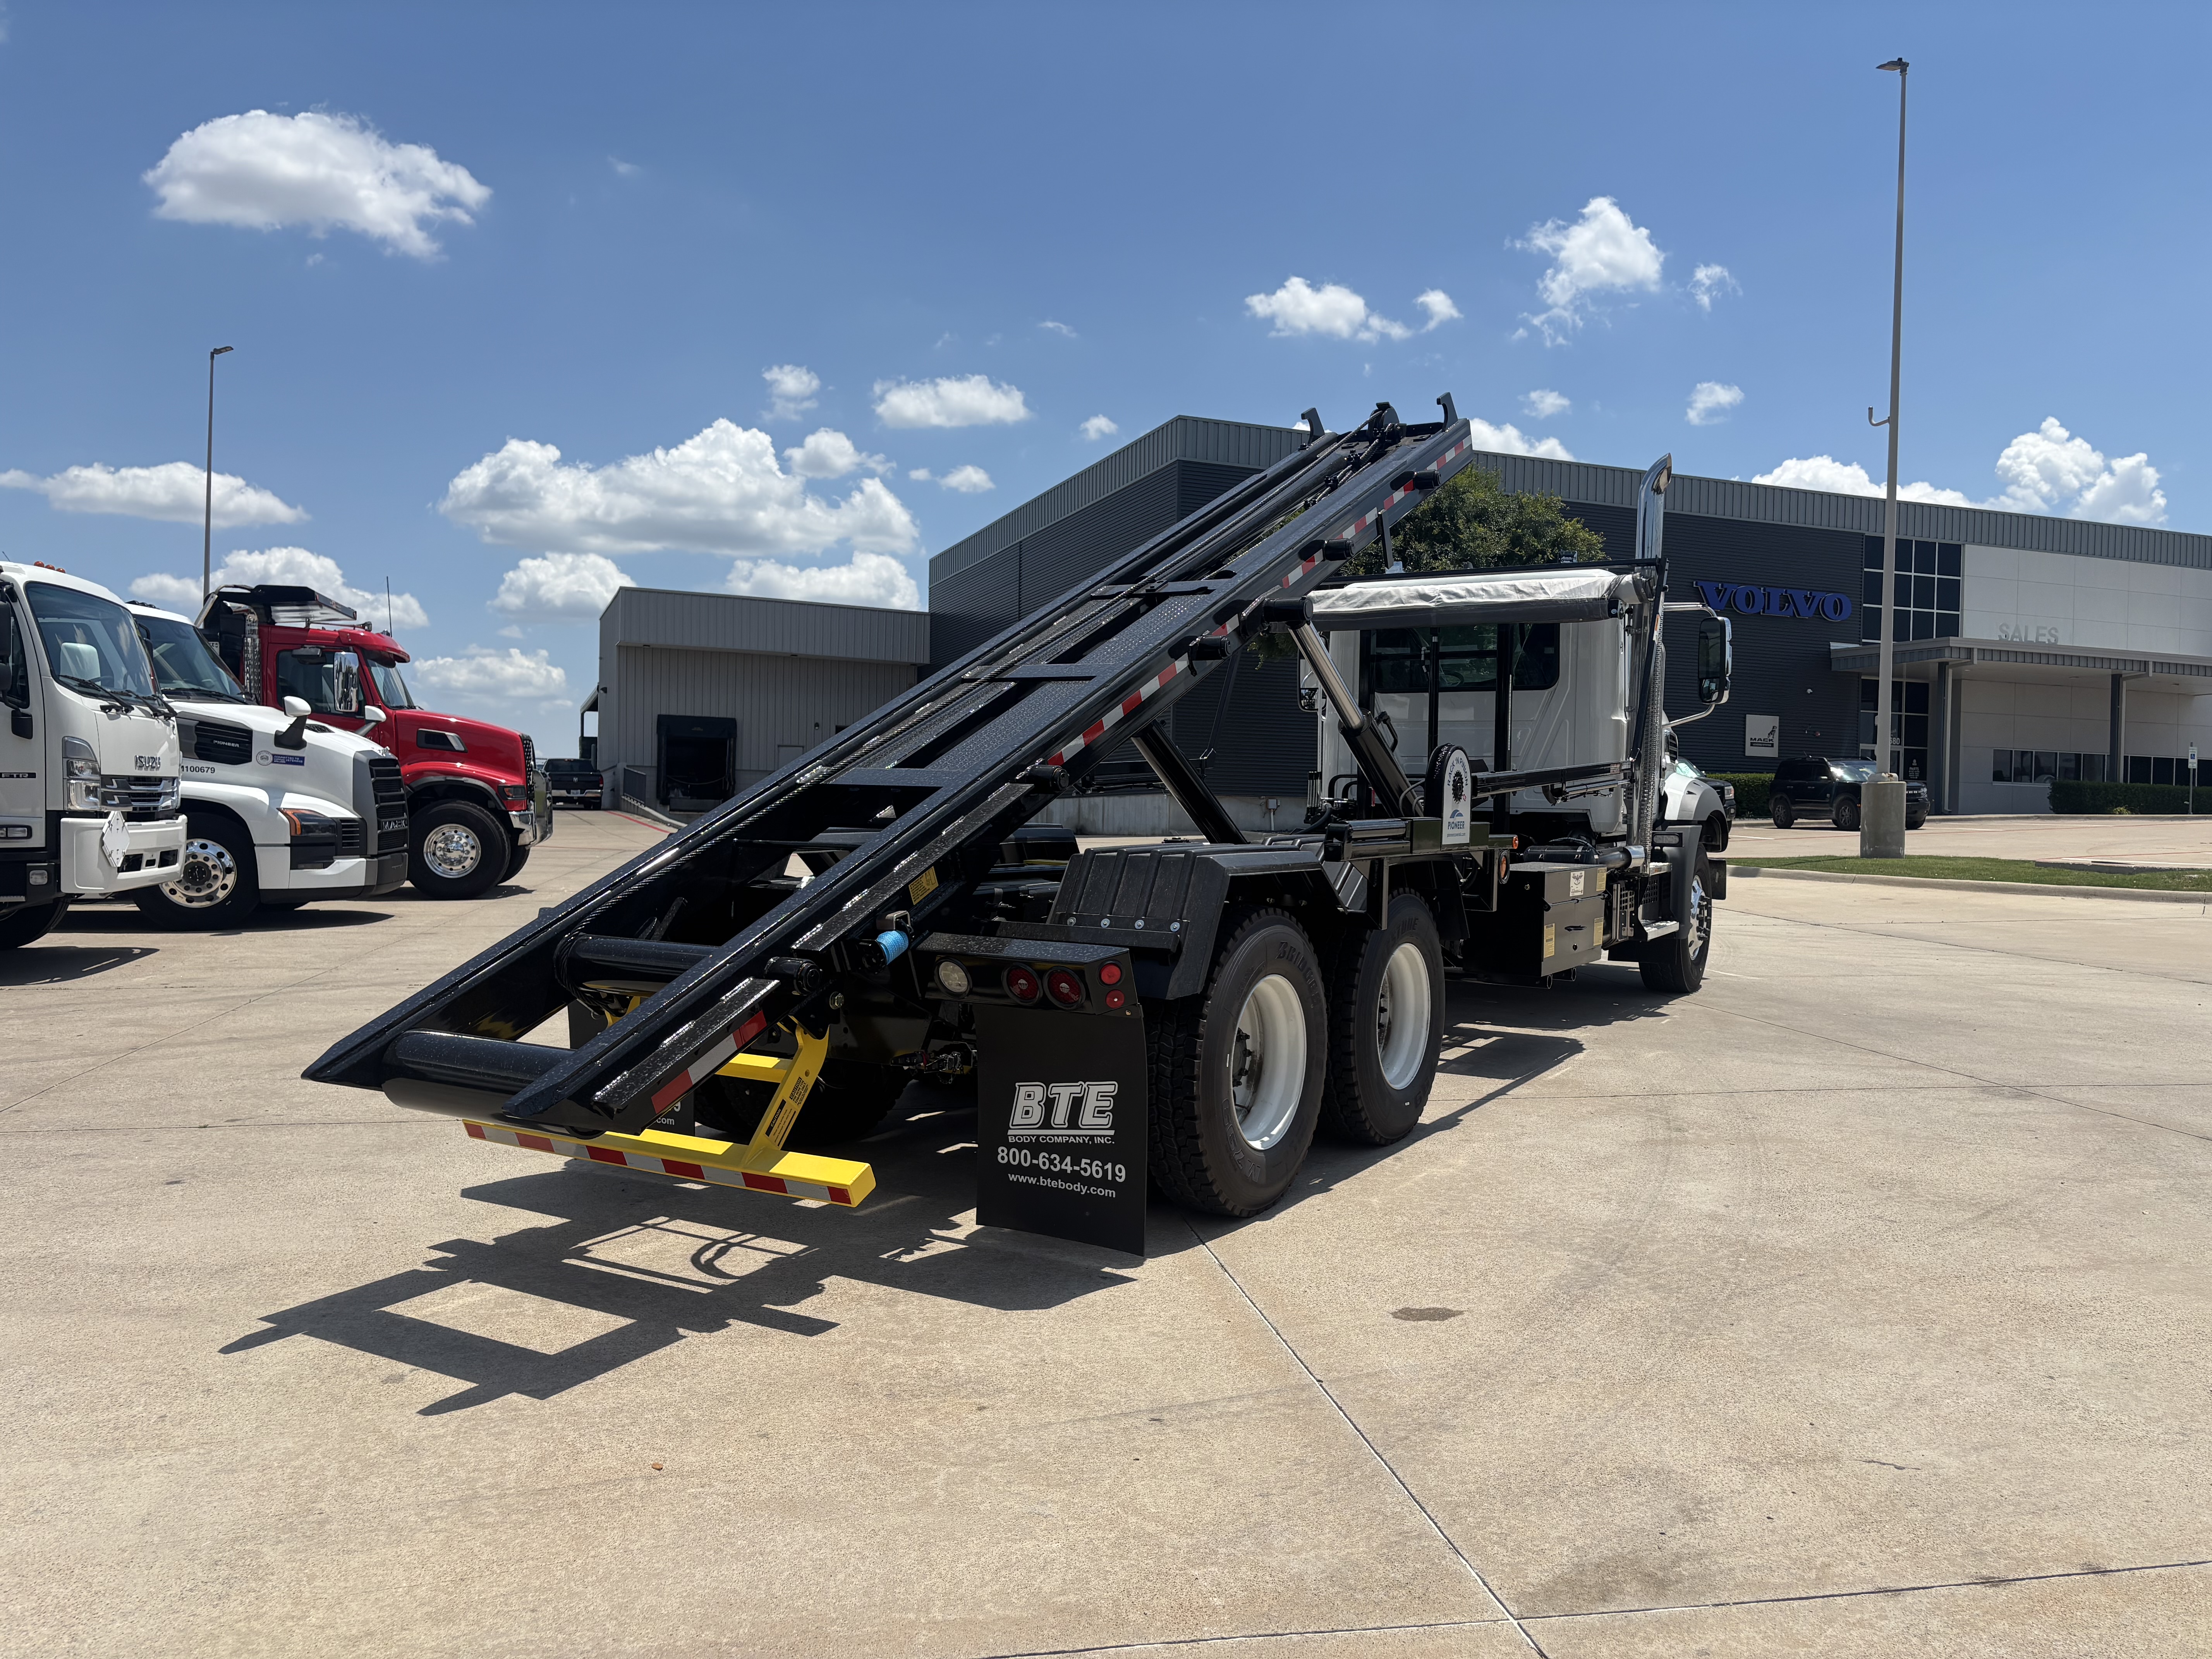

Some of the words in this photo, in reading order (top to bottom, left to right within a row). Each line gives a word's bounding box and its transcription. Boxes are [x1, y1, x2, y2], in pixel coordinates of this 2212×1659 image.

[1693, 581, 1852, 622] VOLVO
[1998, 622, 2059, 645] SALES
[213, 740, 239, 748] PIONEER
[134, 755, 161, 771] ISUZU
[1447, 761, 1455, 786] RACK
[1459, 757, 1468, 786] PINION
[382, 819, 407, 830] MACK
[1448, 821, 1465, 830] PIONEER
[790, 1078, 802, 1098] CAUTION
[1009, 1081, 1118, 1128] BTE
[770, 1108, 781, 1127] CAUTION
[1039, 1136, 1092, 1144] COMPANY,
[997, 1146, 1126, 1182] 800-634-5619
[1008, 1173, 1116, 1198] www.btebody.com
